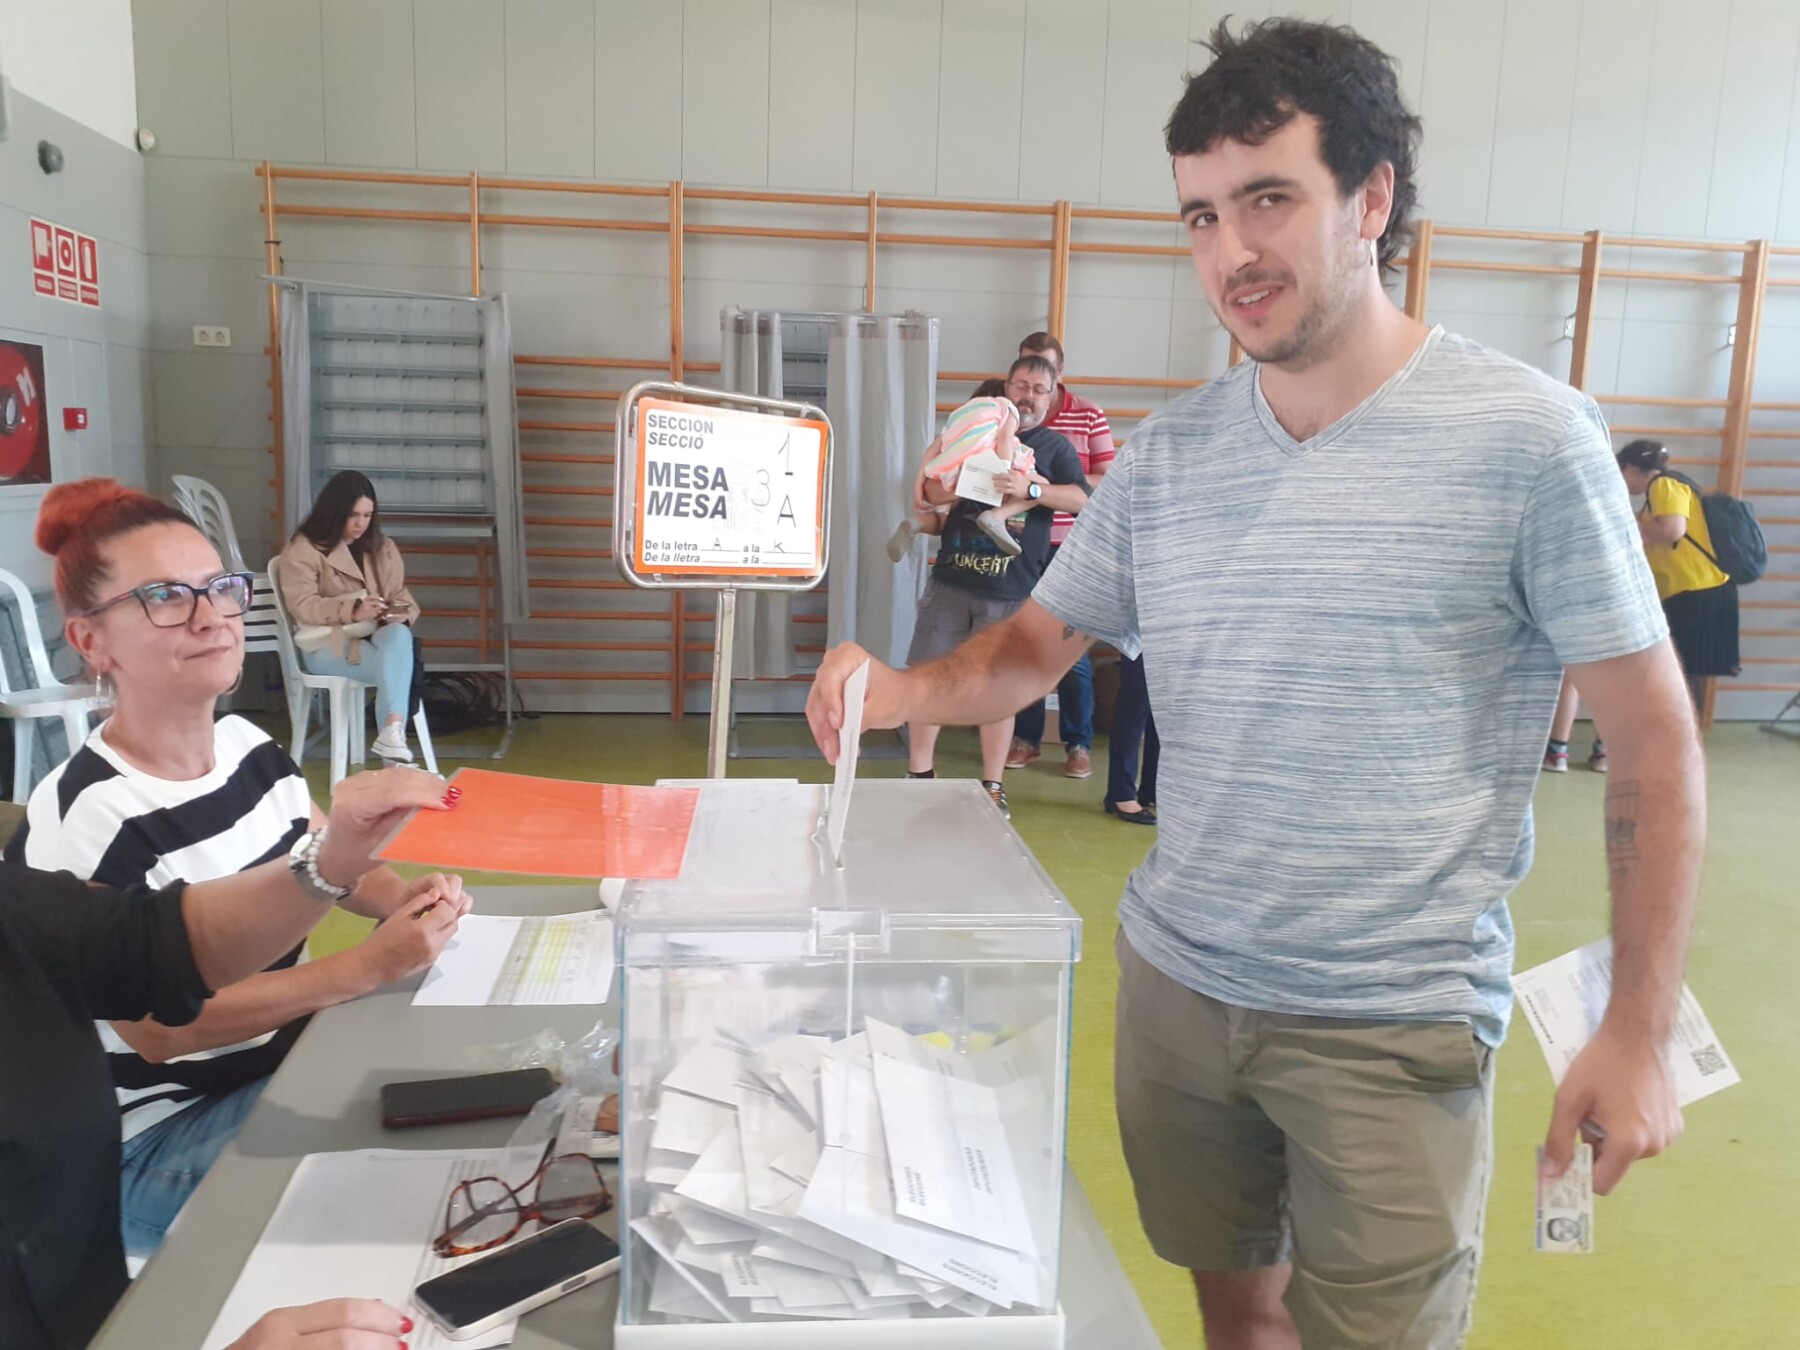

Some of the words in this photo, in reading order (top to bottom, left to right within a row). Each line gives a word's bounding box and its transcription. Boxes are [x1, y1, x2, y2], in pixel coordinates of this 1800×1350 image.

[648, 414, 714, 434] SECCIÓN
[648, 431, 704, 450] SECCIÓ
[648, 460, 729, 492] MESA
[647, 490, 728, 520] MESA
[777, 493, 796, 528] A
[645, 539, 659, 550] De
[662, 540, 671, 550] la
[674, 540, 698, 551] letra
[743, 545, 749, 553] a
[751, 543, 760, 553] la
[773, 539, 786, 554] K
[644, 552, 658, 561] De
[661, 552, 671, 562] la
[673, 552, 700, 563] lletra
[742, 556, 749, 564] a
[750, 554, 760, 564] la
